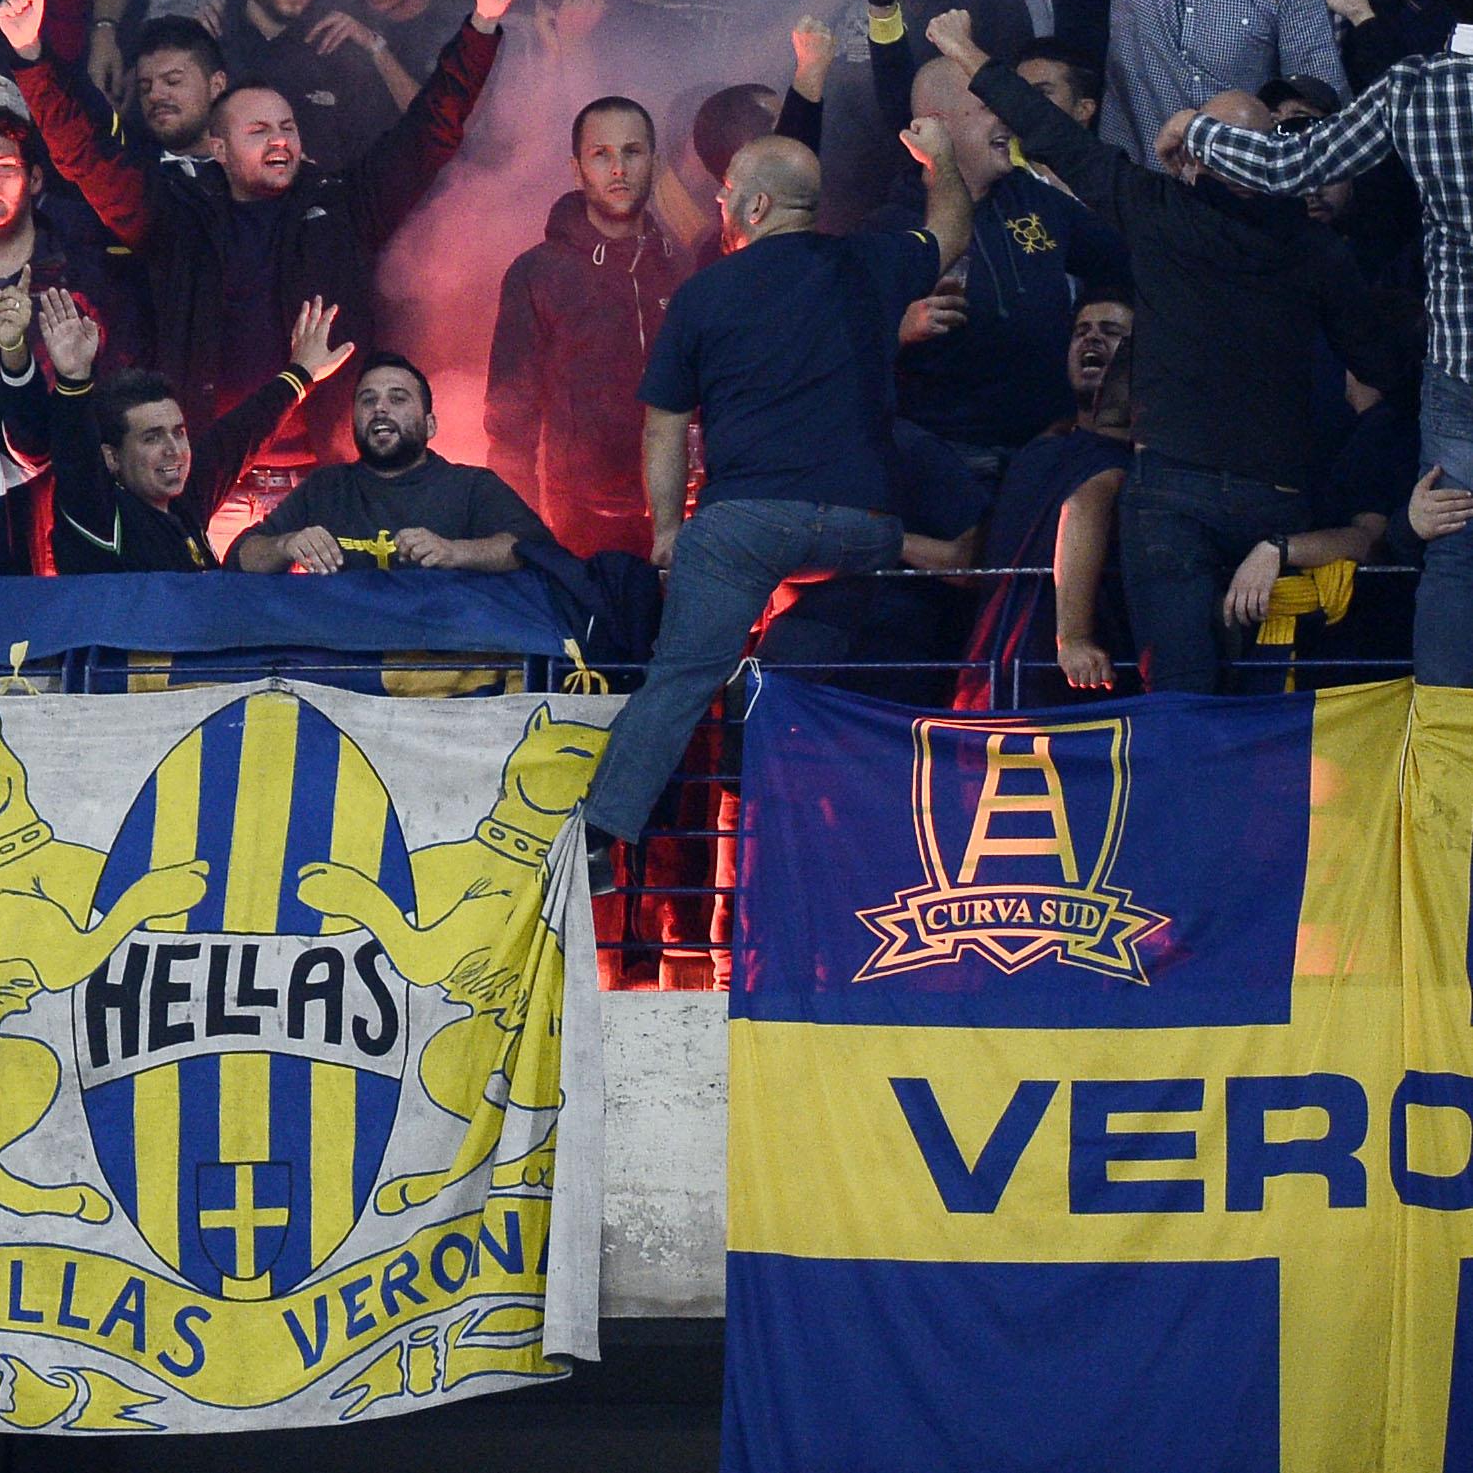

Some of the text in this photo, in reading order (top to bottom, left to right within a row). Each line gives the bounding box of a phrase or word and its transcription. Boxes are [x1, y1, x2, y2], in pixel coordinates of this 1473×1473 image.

[924, 898, 1101, 931] CURVA SUD
[83, 942, 404, 1068] HELLAS
[281, 1211, 551, 1370] VERON
